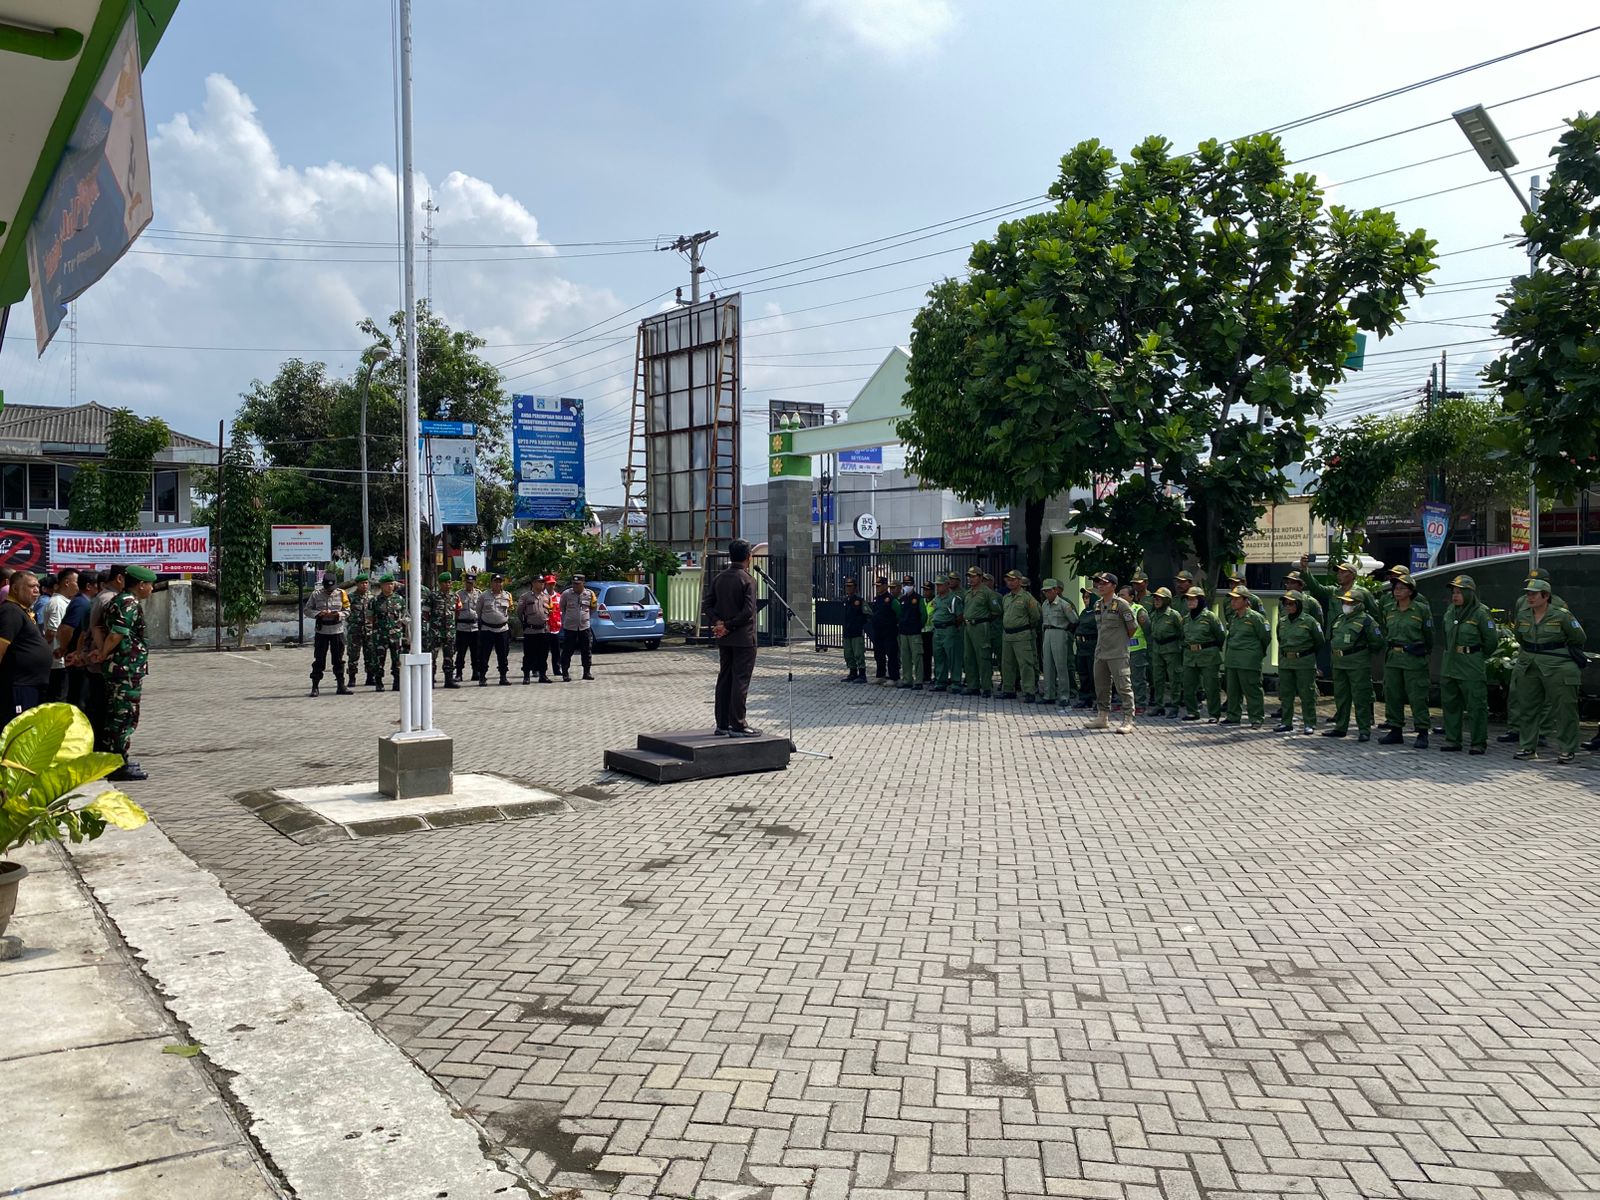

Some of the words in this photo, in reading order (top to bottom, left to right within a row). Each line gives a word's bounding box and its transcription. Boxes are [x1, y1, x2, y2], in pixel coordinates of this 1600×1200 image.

[57, 538, 121, 553] KAWASAN
[124, 538, 164, 553] TANPA
[168, 537, 207, 553] ROKOK
